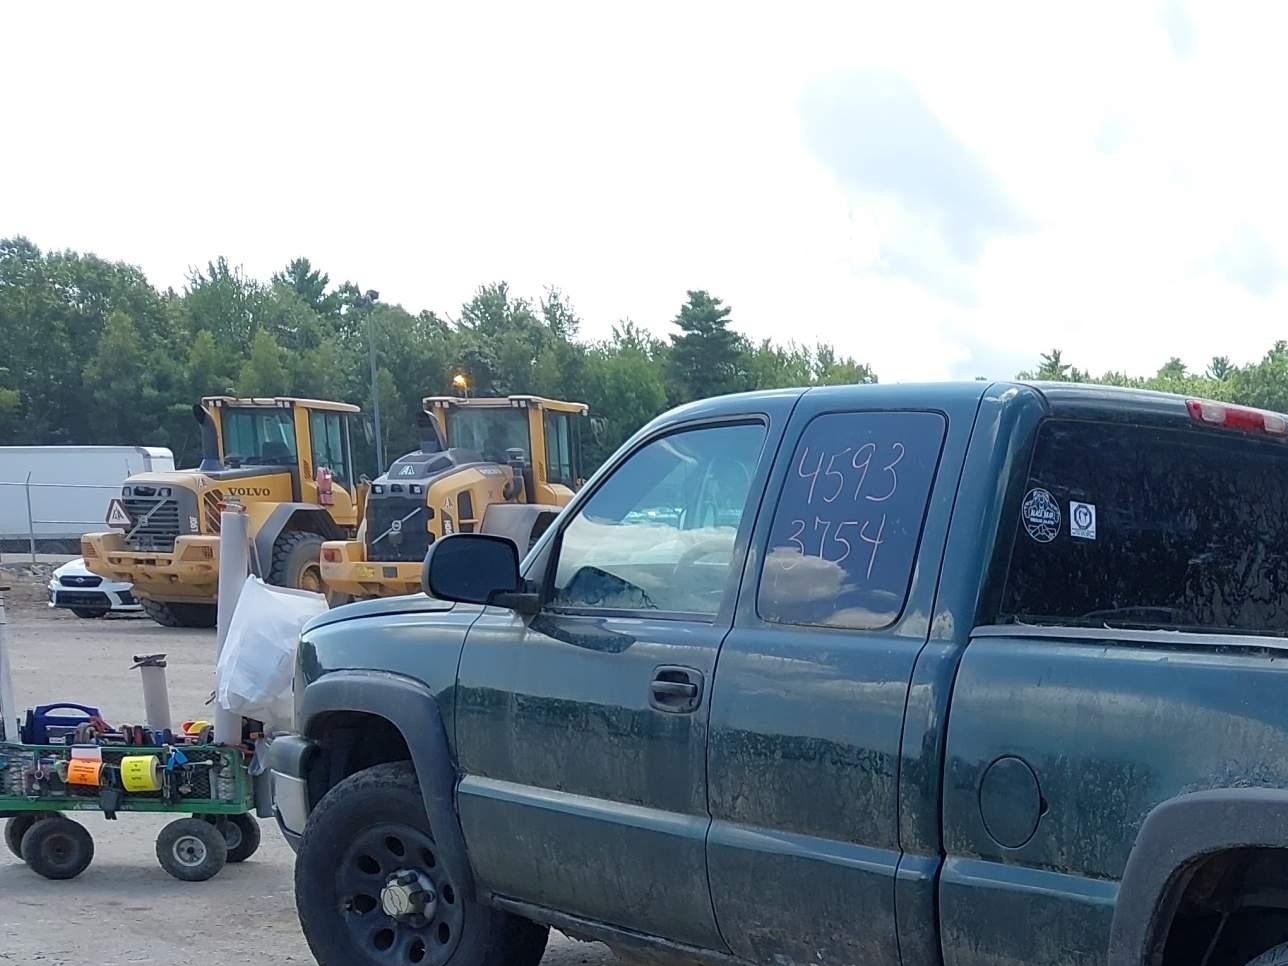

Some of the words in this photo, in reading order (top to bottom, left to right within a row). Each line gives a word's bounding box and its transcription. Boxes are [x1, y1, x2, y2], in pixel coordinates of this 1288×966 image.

[228, 487, 270, 497] VOLVO
[798, 442, 905, 504] 4593
[780, 513, 886, 580] 3754
